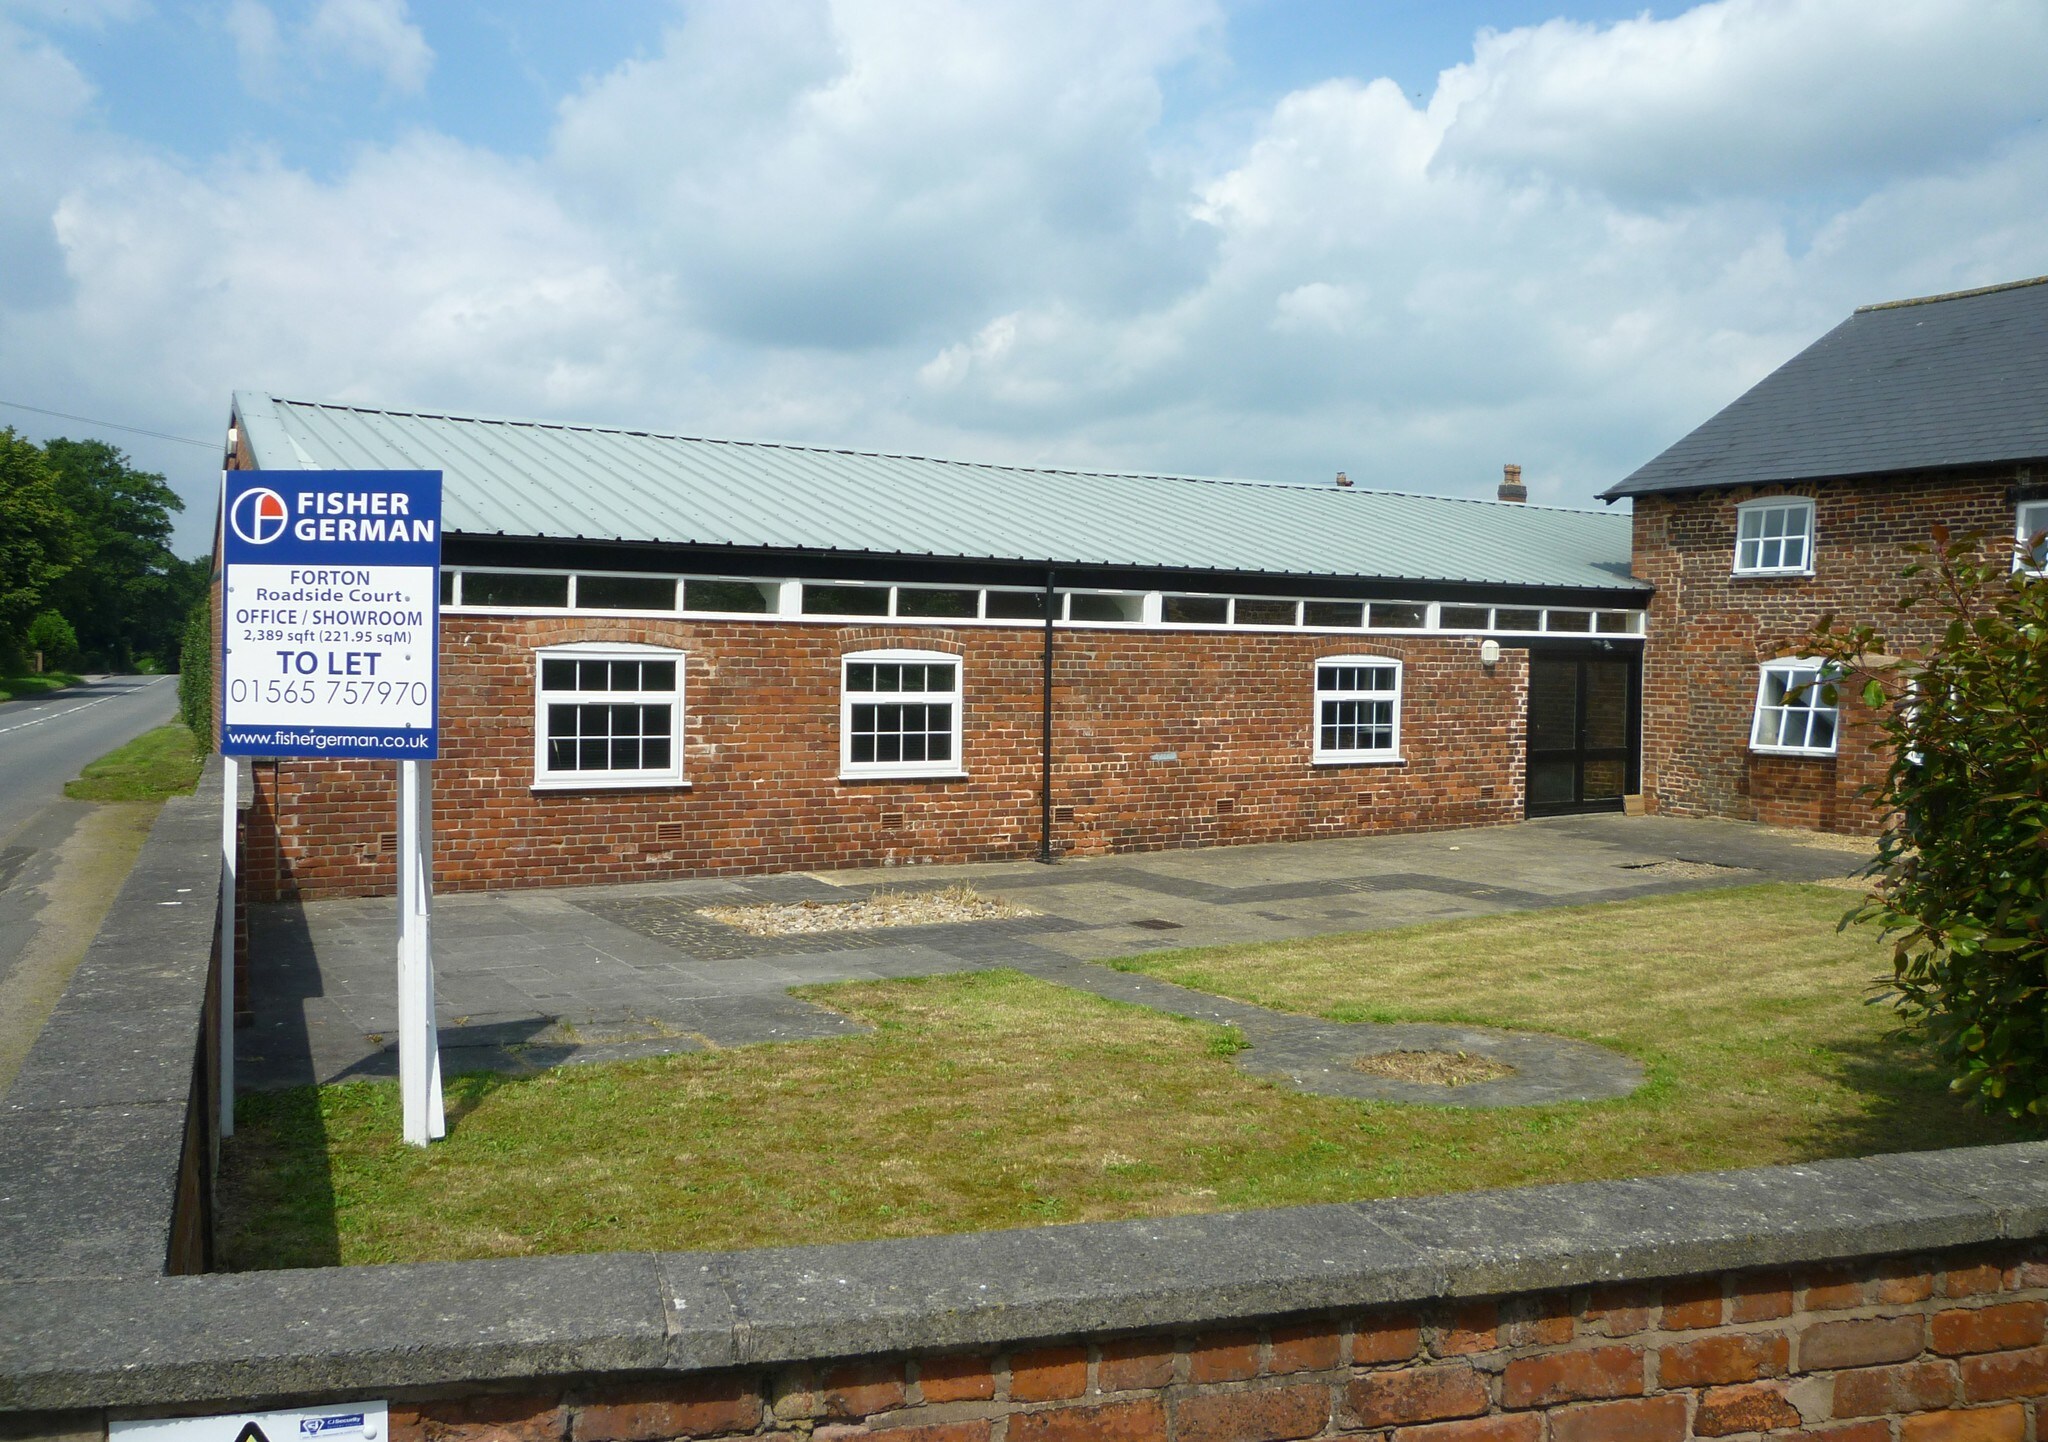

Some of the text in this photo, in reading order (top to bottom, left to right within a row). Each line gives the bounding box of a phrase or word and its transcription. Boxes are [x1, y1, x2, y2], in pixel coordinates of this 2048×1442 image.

[297, 492, 409, 514] FISHER
[295, 519, 434, 542] GERMAN
[291, 571, 370, 585] FORTON
[256, 588, 402, 602] Roadside Court
[236, 609, 422, 626] OFFICE / SHOWROOM
[244, 630, 412, 644] 2,389 sqft (221.95 sqM)
[277, 651, 381, 675] TO LET
[231, 679, 427, 705] 01565 757970
[229, 732, 428, 749] www.fishergerman.co.uk
